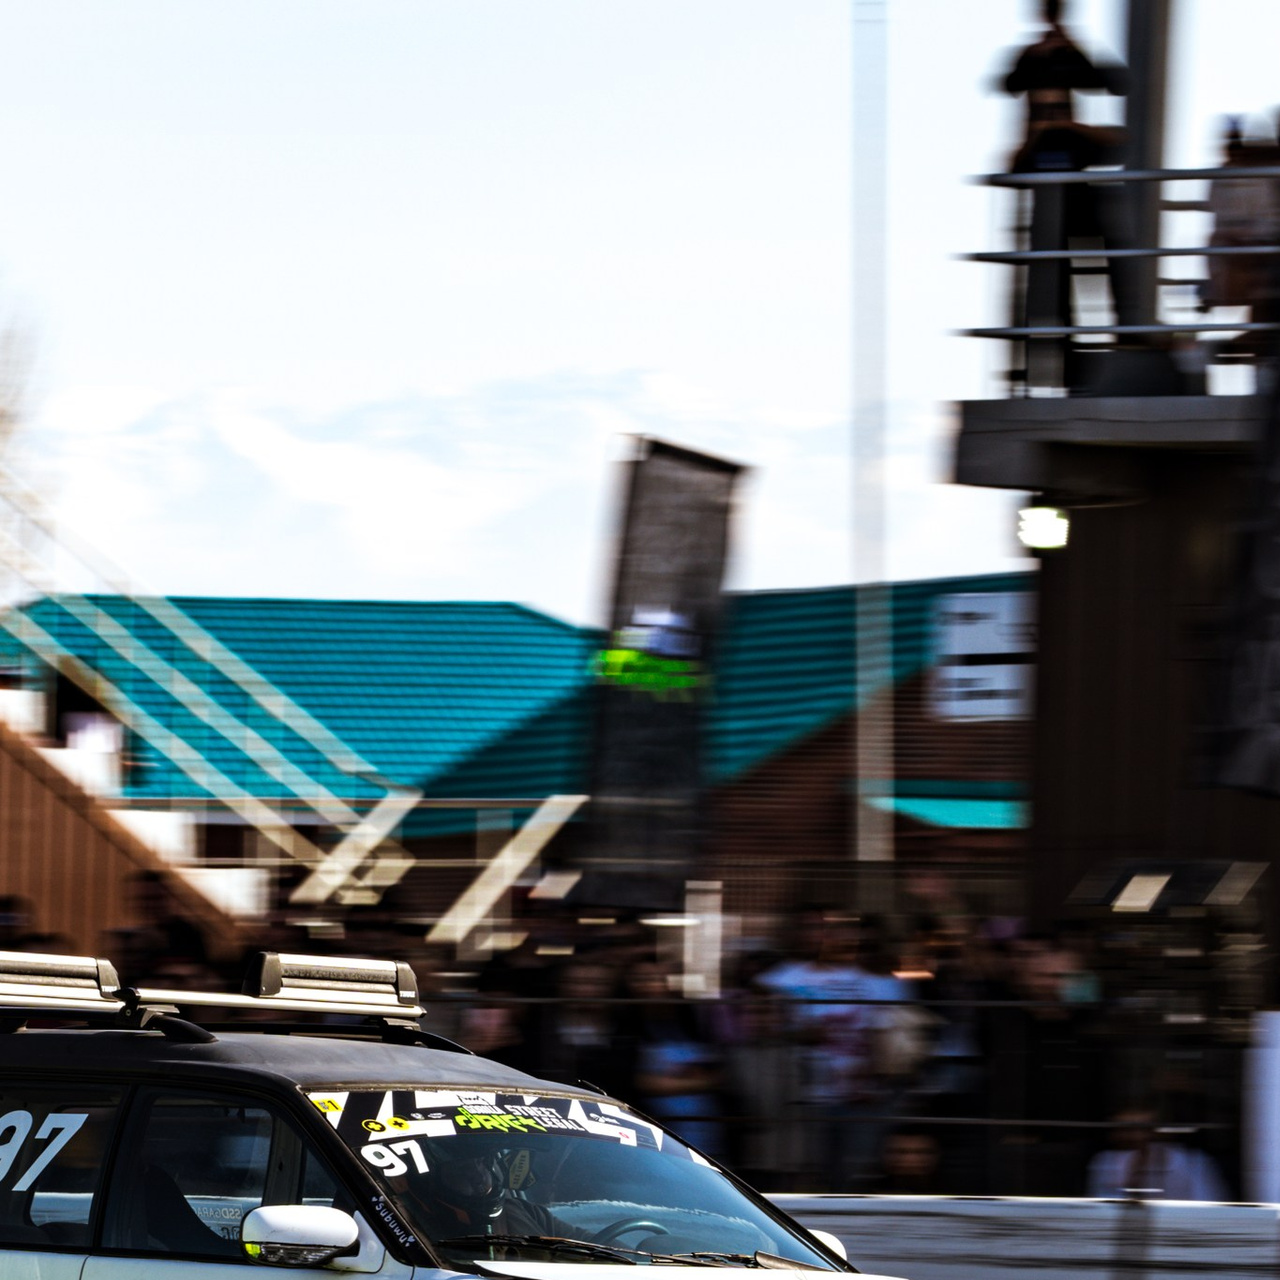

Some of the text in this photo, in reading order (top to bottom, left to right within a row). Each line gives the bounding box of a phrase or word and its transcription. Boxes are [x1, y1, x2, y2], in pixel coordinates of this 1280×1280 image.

[504, 1105, 563, 1119] STREET
[534, 1116, 585, 1131] LEGAL
[361, 1140, 429, 1177] 97
